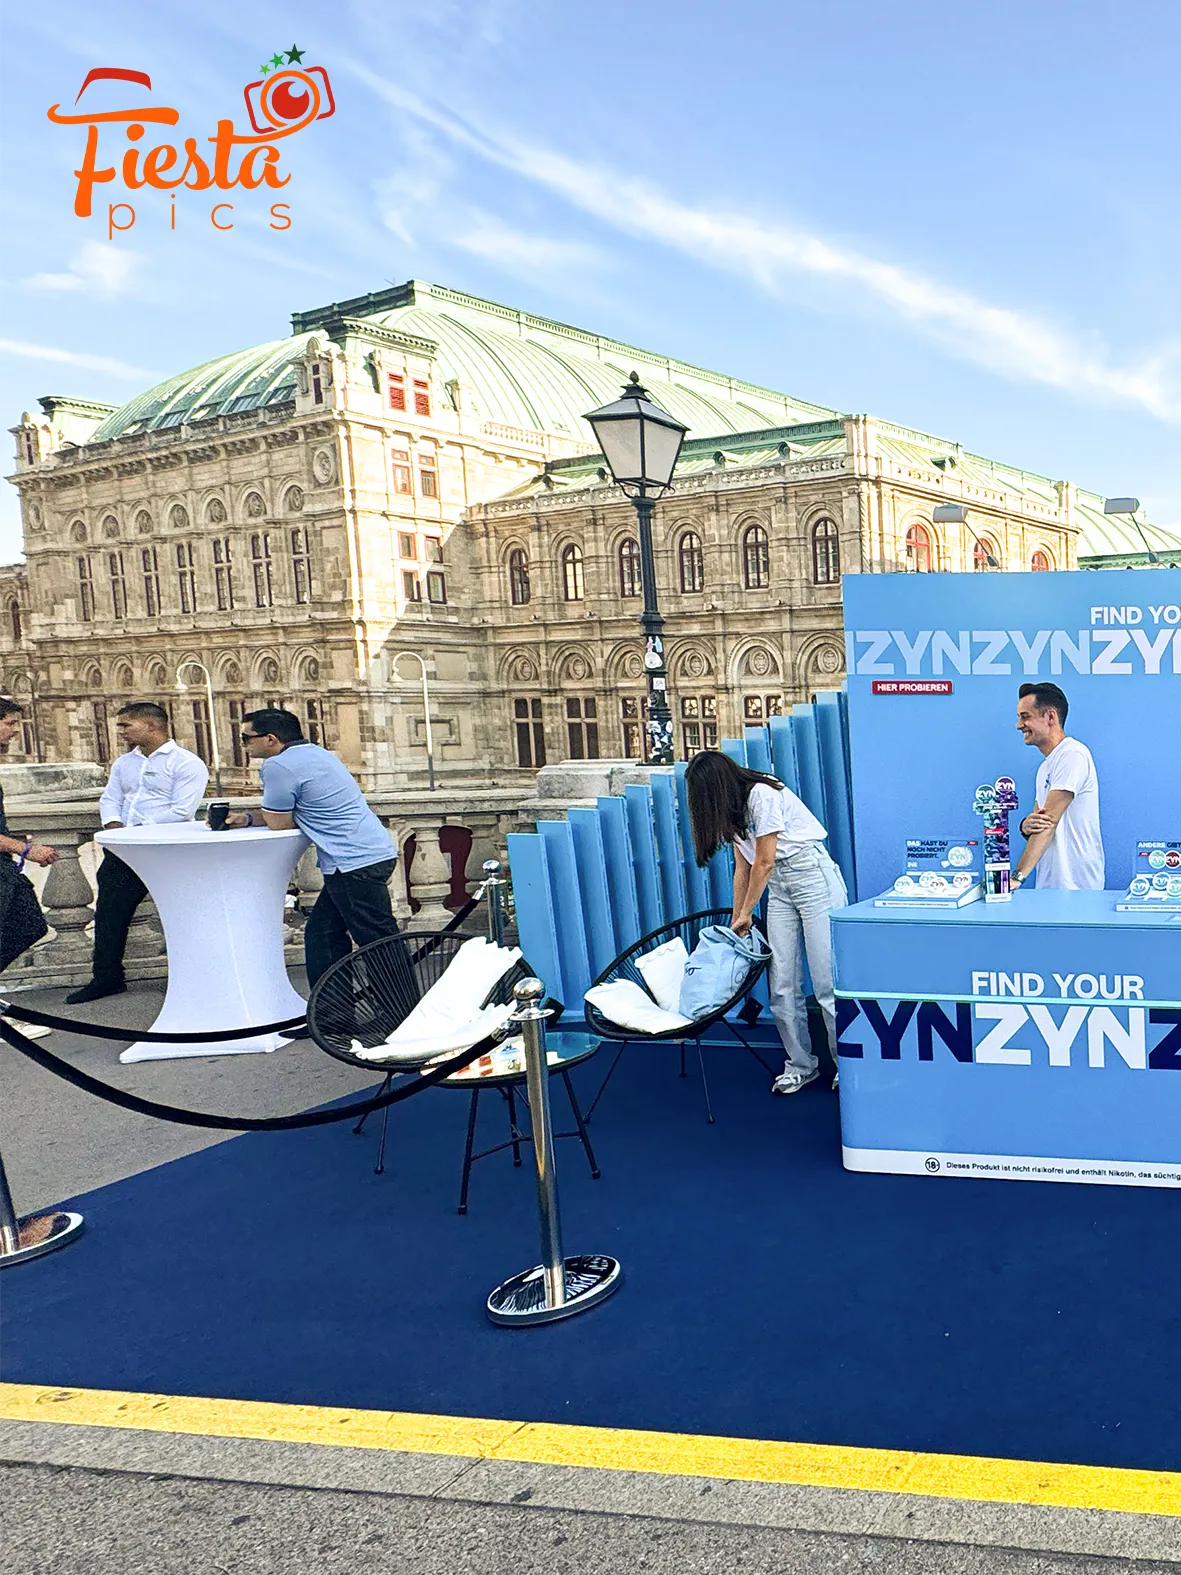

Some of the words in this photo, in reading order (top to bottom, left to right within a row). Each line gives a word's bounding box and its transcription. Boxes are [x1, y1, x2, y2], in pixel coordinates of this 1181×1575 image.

[1090, 606, 1143, 626] FIND
[877, 683, 898, 693] HIER
[899, 683, 949, 693] PROBIEREN
[971, 971, 1045, 997] FIND
[1052, 973, 1145, 1000] YOUR
[975, 1002, 1147, 1071] ZYN
[946, 1162, 970, 1170] Dieses
[972, 1162, 1000, 1172] Produkt
[1001, 1164, 1011, 1172] ist
[1012, 1165, 1030, 1173] nicht
[1032, 1166, 1064, 1174] risikofrei
[1081, 1168, 1107, 1176] enthält
[1108, 1170, 1136, 1178] Nikotin,
[1153, 1171, 1181, 1181] süchtig
